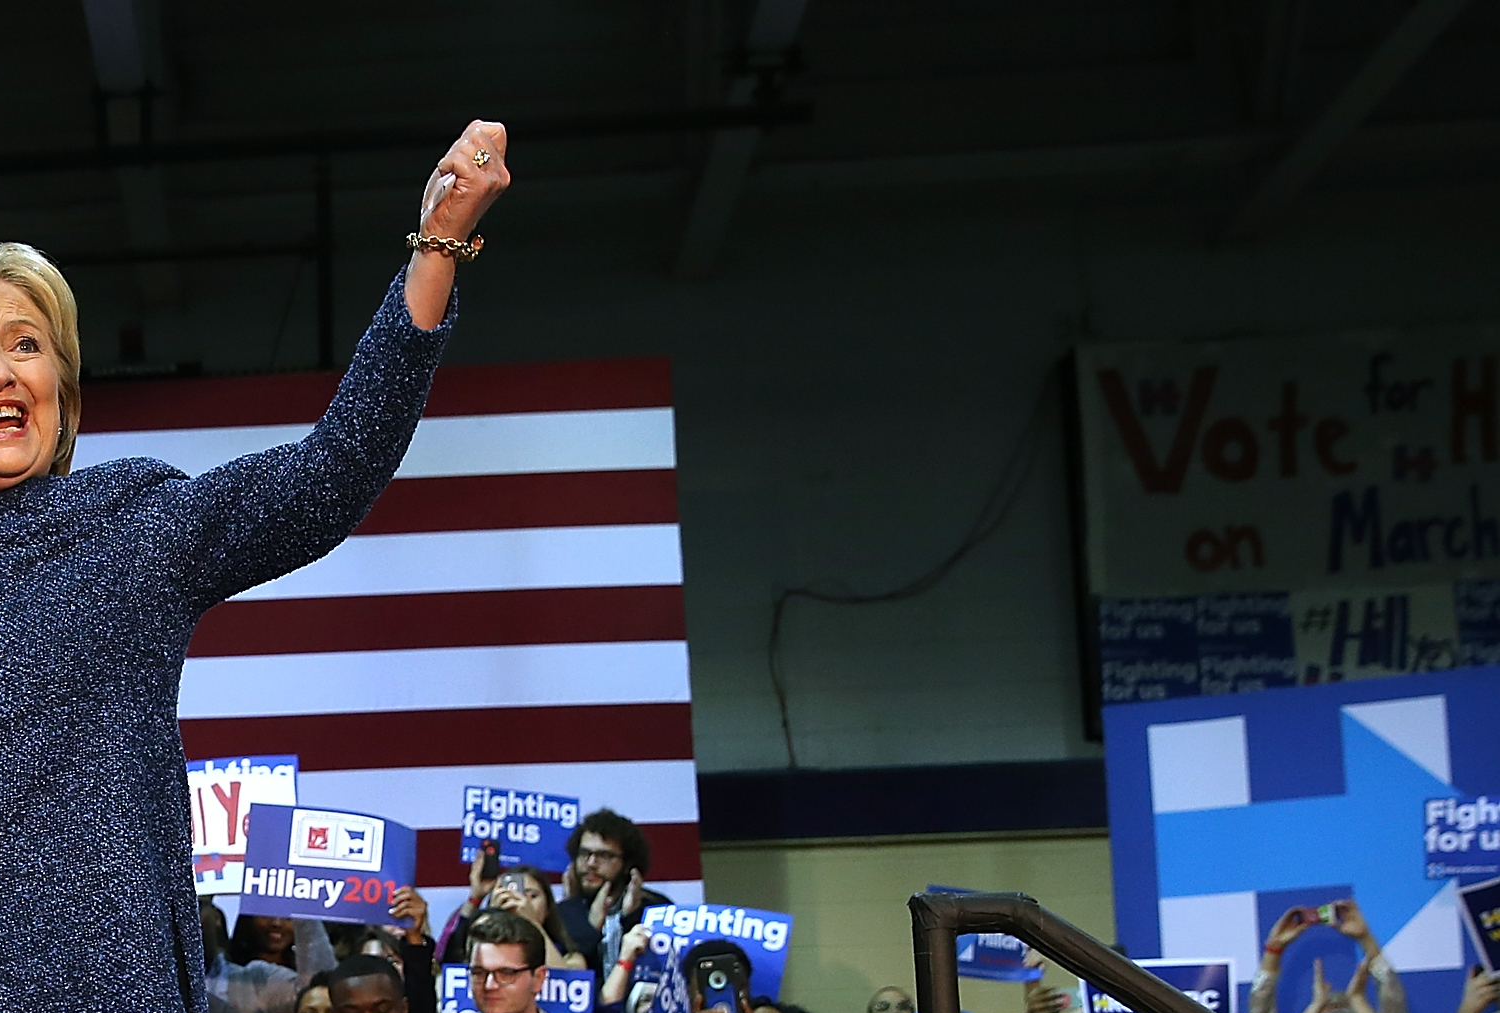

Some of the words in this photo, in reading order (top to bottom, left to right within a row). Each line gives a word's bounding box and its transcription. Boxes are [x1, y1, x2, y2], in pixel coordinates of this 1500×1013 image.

[1098, 366, 1359, 493] Vote
[1365, 350, 1434, 415] for
[1450, 355, 1500, 464] H
[1184, 524, 1265, 573] on
[1327, 483, 1500, 574] March
[462, 811, 505, 840] for
[507, 821, 541, 844] us
[464, 787, 579, 829] Fighting
[1425, 795, 1500, 831] Figh
[1424, 826, 1476, 854] for
[1478, 827, 1500, 852] u
[243, 867, 410, 909] Hillary201
[642, 903, 789, 952] Fighting
[650, 931, 691, 956] or
